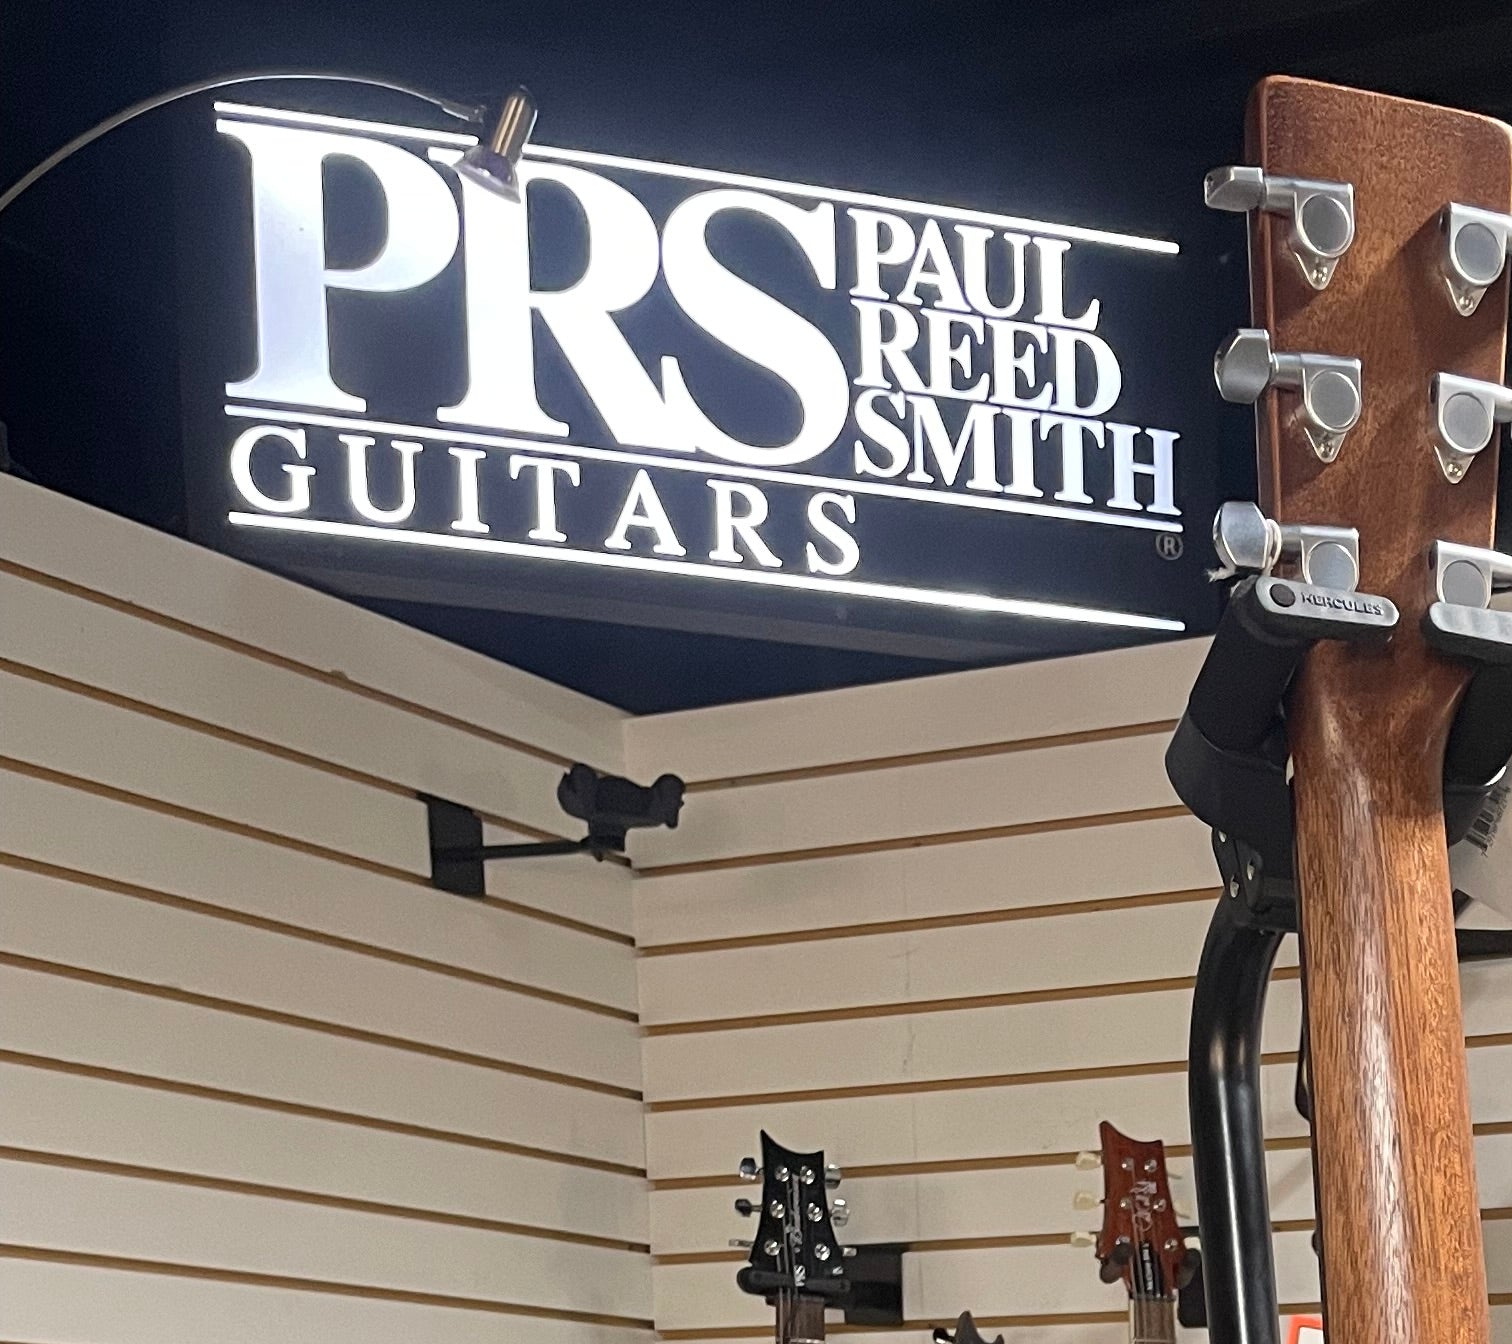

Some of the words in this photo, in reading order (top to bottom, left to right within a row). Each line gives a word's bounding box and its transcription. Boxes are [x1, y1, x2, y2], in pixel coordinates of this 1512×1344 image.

[216, 118, 850, 467] PRS
[847, 207, 1101, 332] PAUL
[851, 298, 1123, 417] REED
[228, 424, 862, 576] GUITARS
[852, 390, 1182, 517] SMITH
[1300, 592, 1384, 616] HERCULES
